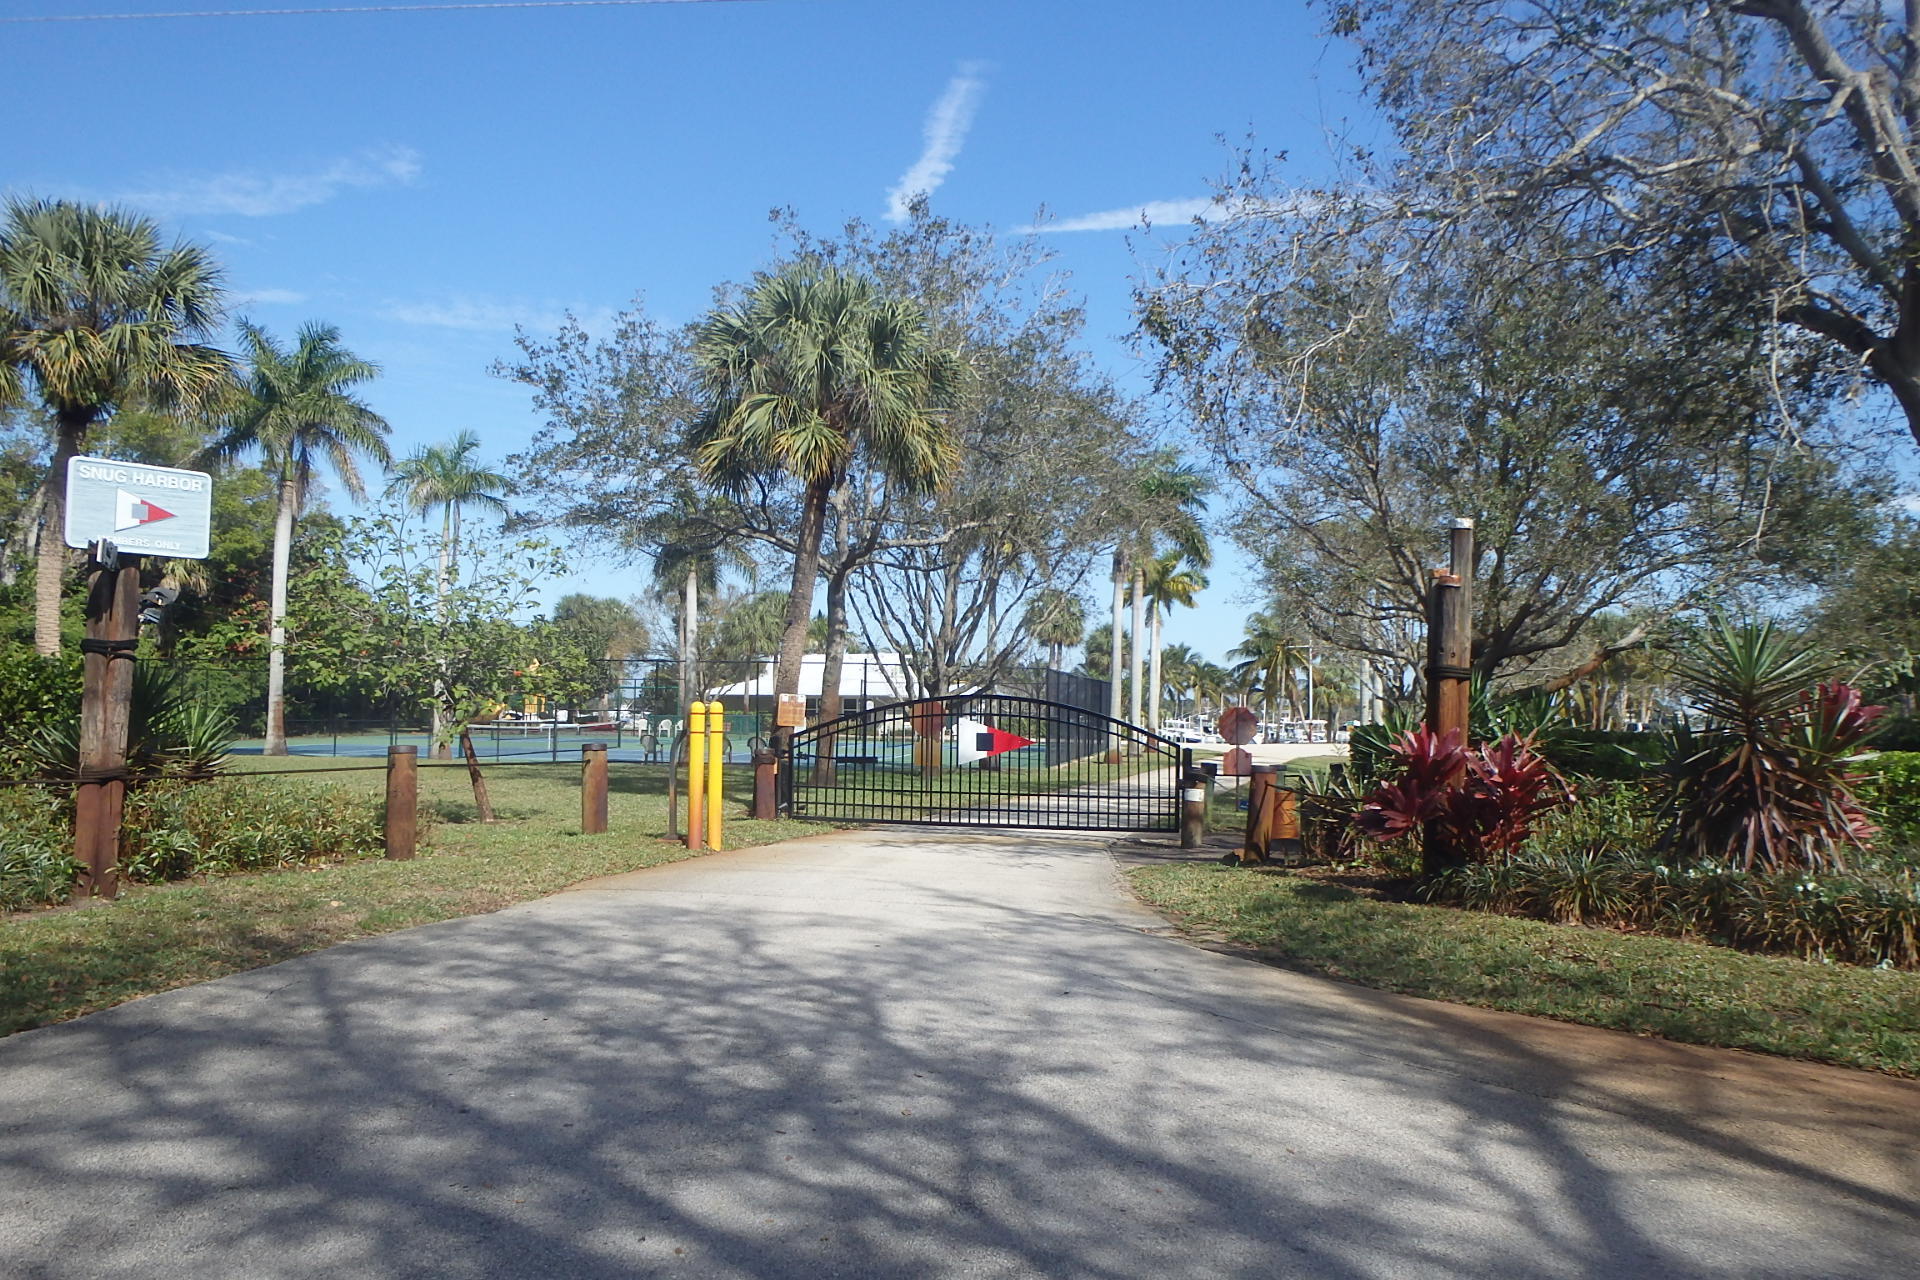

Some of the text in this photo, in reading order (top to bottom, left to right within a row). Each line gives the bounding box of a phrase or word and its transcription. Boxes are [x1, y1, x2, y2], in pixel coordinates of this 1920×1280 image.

[79, 465, 202, 491] SNUG HARBOR
[155, 540, 181, 550] ONLY
